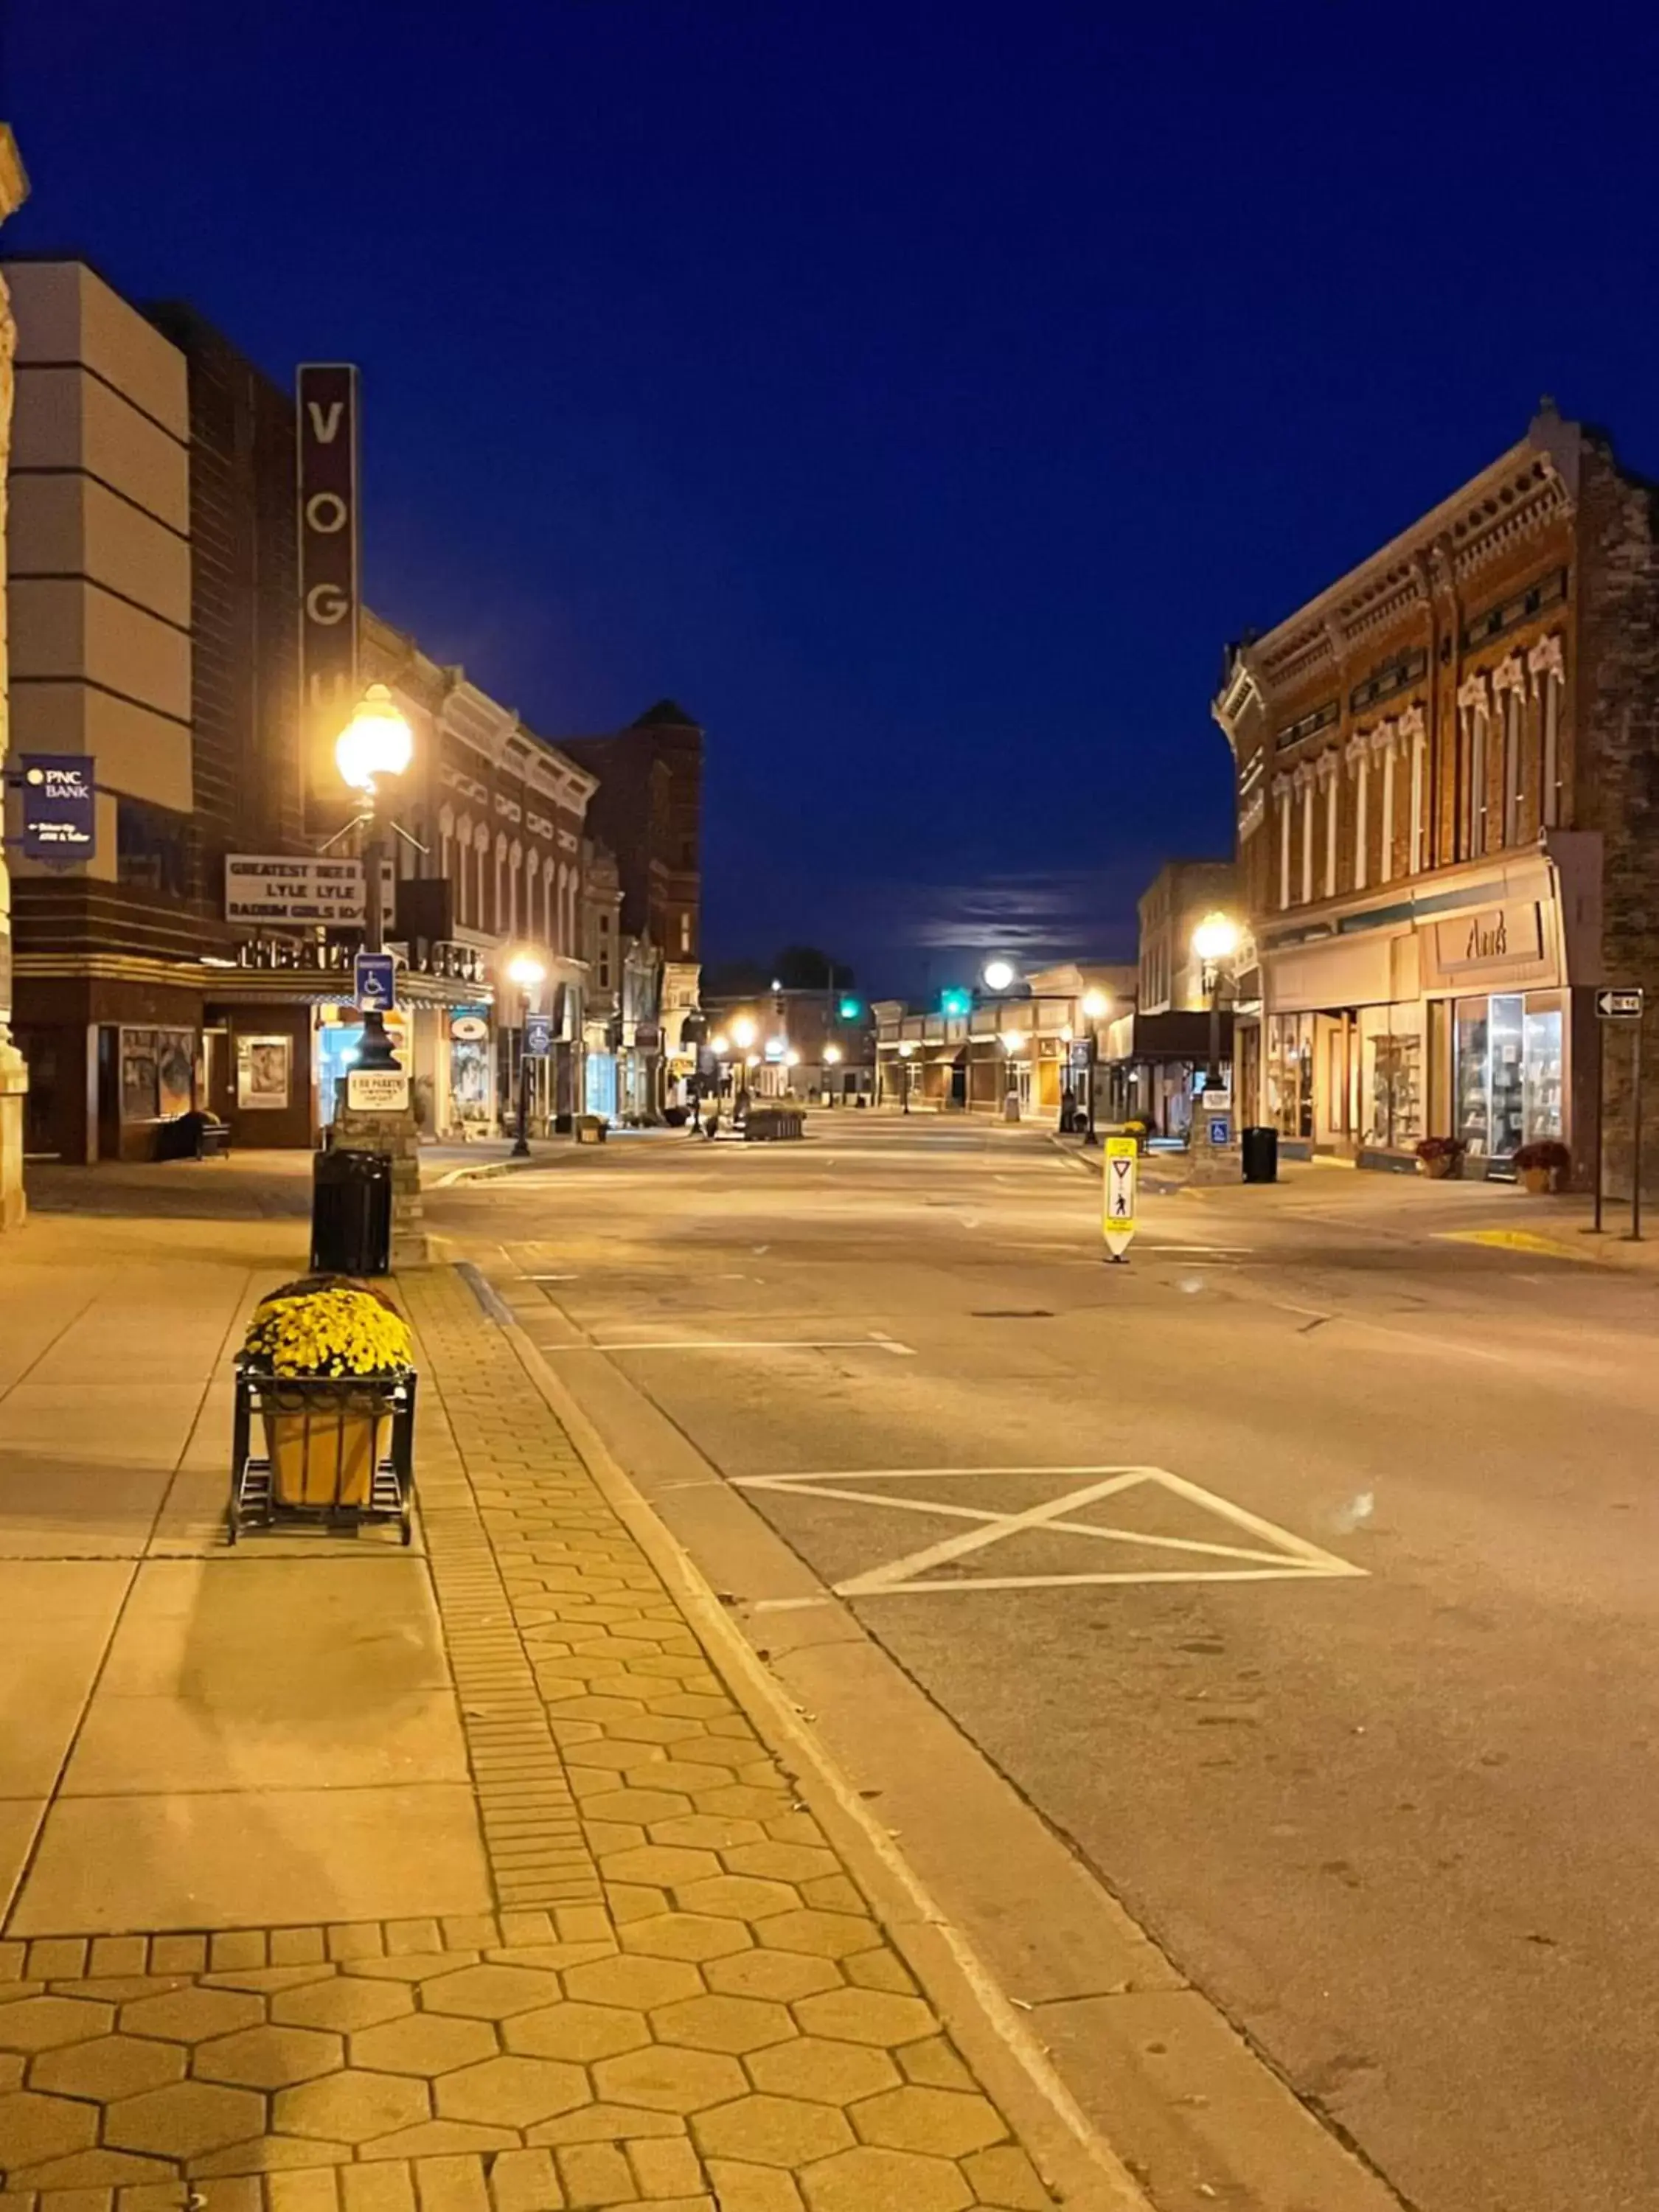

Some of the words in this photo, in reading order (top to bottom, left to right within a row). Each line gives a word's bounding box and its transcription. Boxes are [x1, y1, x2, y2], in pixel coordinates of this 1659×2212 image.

[46, 770, 82, 785] PNC
[46, 785, 89, 799] BANK
[230, 862, 308, 877] GREATEST
[265, 883, 307, 898] LYLE
[316, 885, 355, 900] LYLE
